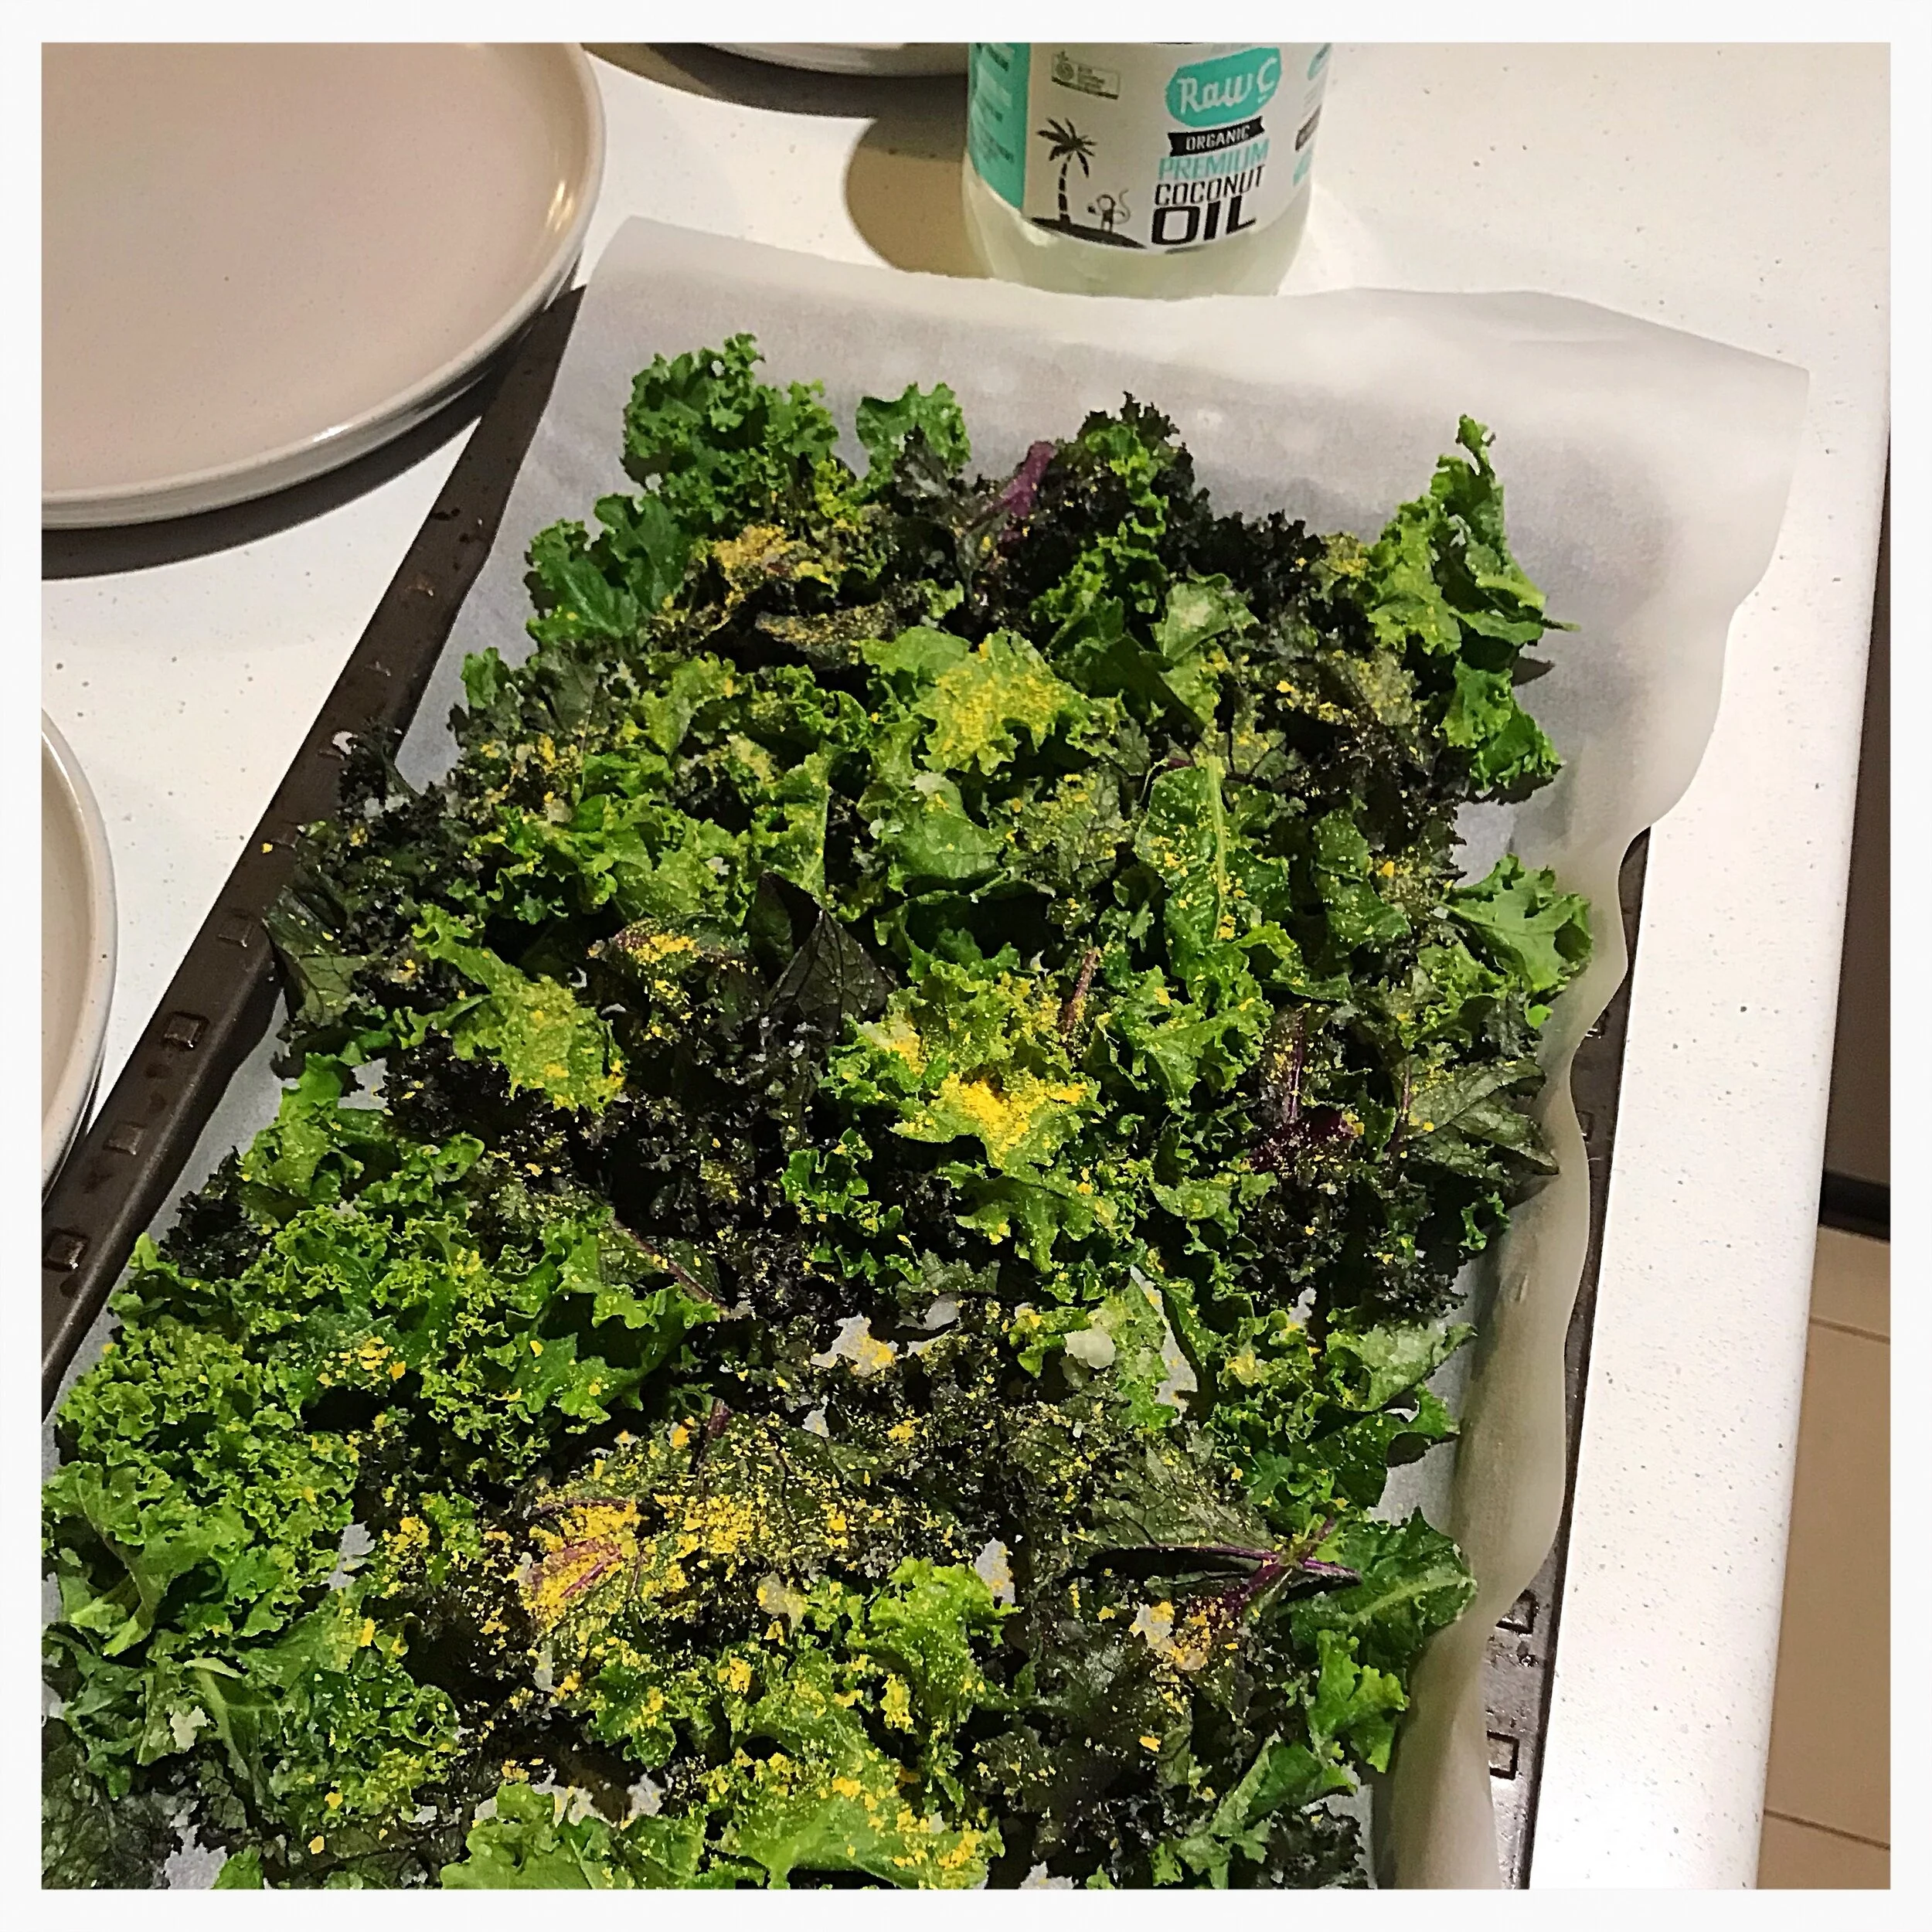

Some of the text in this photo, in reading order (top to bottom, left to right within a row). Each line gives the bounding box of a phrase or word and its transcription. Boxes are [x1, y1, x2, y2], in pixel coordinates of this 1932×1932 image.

[1176, 73, 1254, 116] Raw
[1185, 124, 1251, 151] ORGANIC
[1158, 138, 1270, 181] PREMIUM
[1155, 164, 1265, 206] COCONUT
[1151, 195, 1257, 245] OIL
